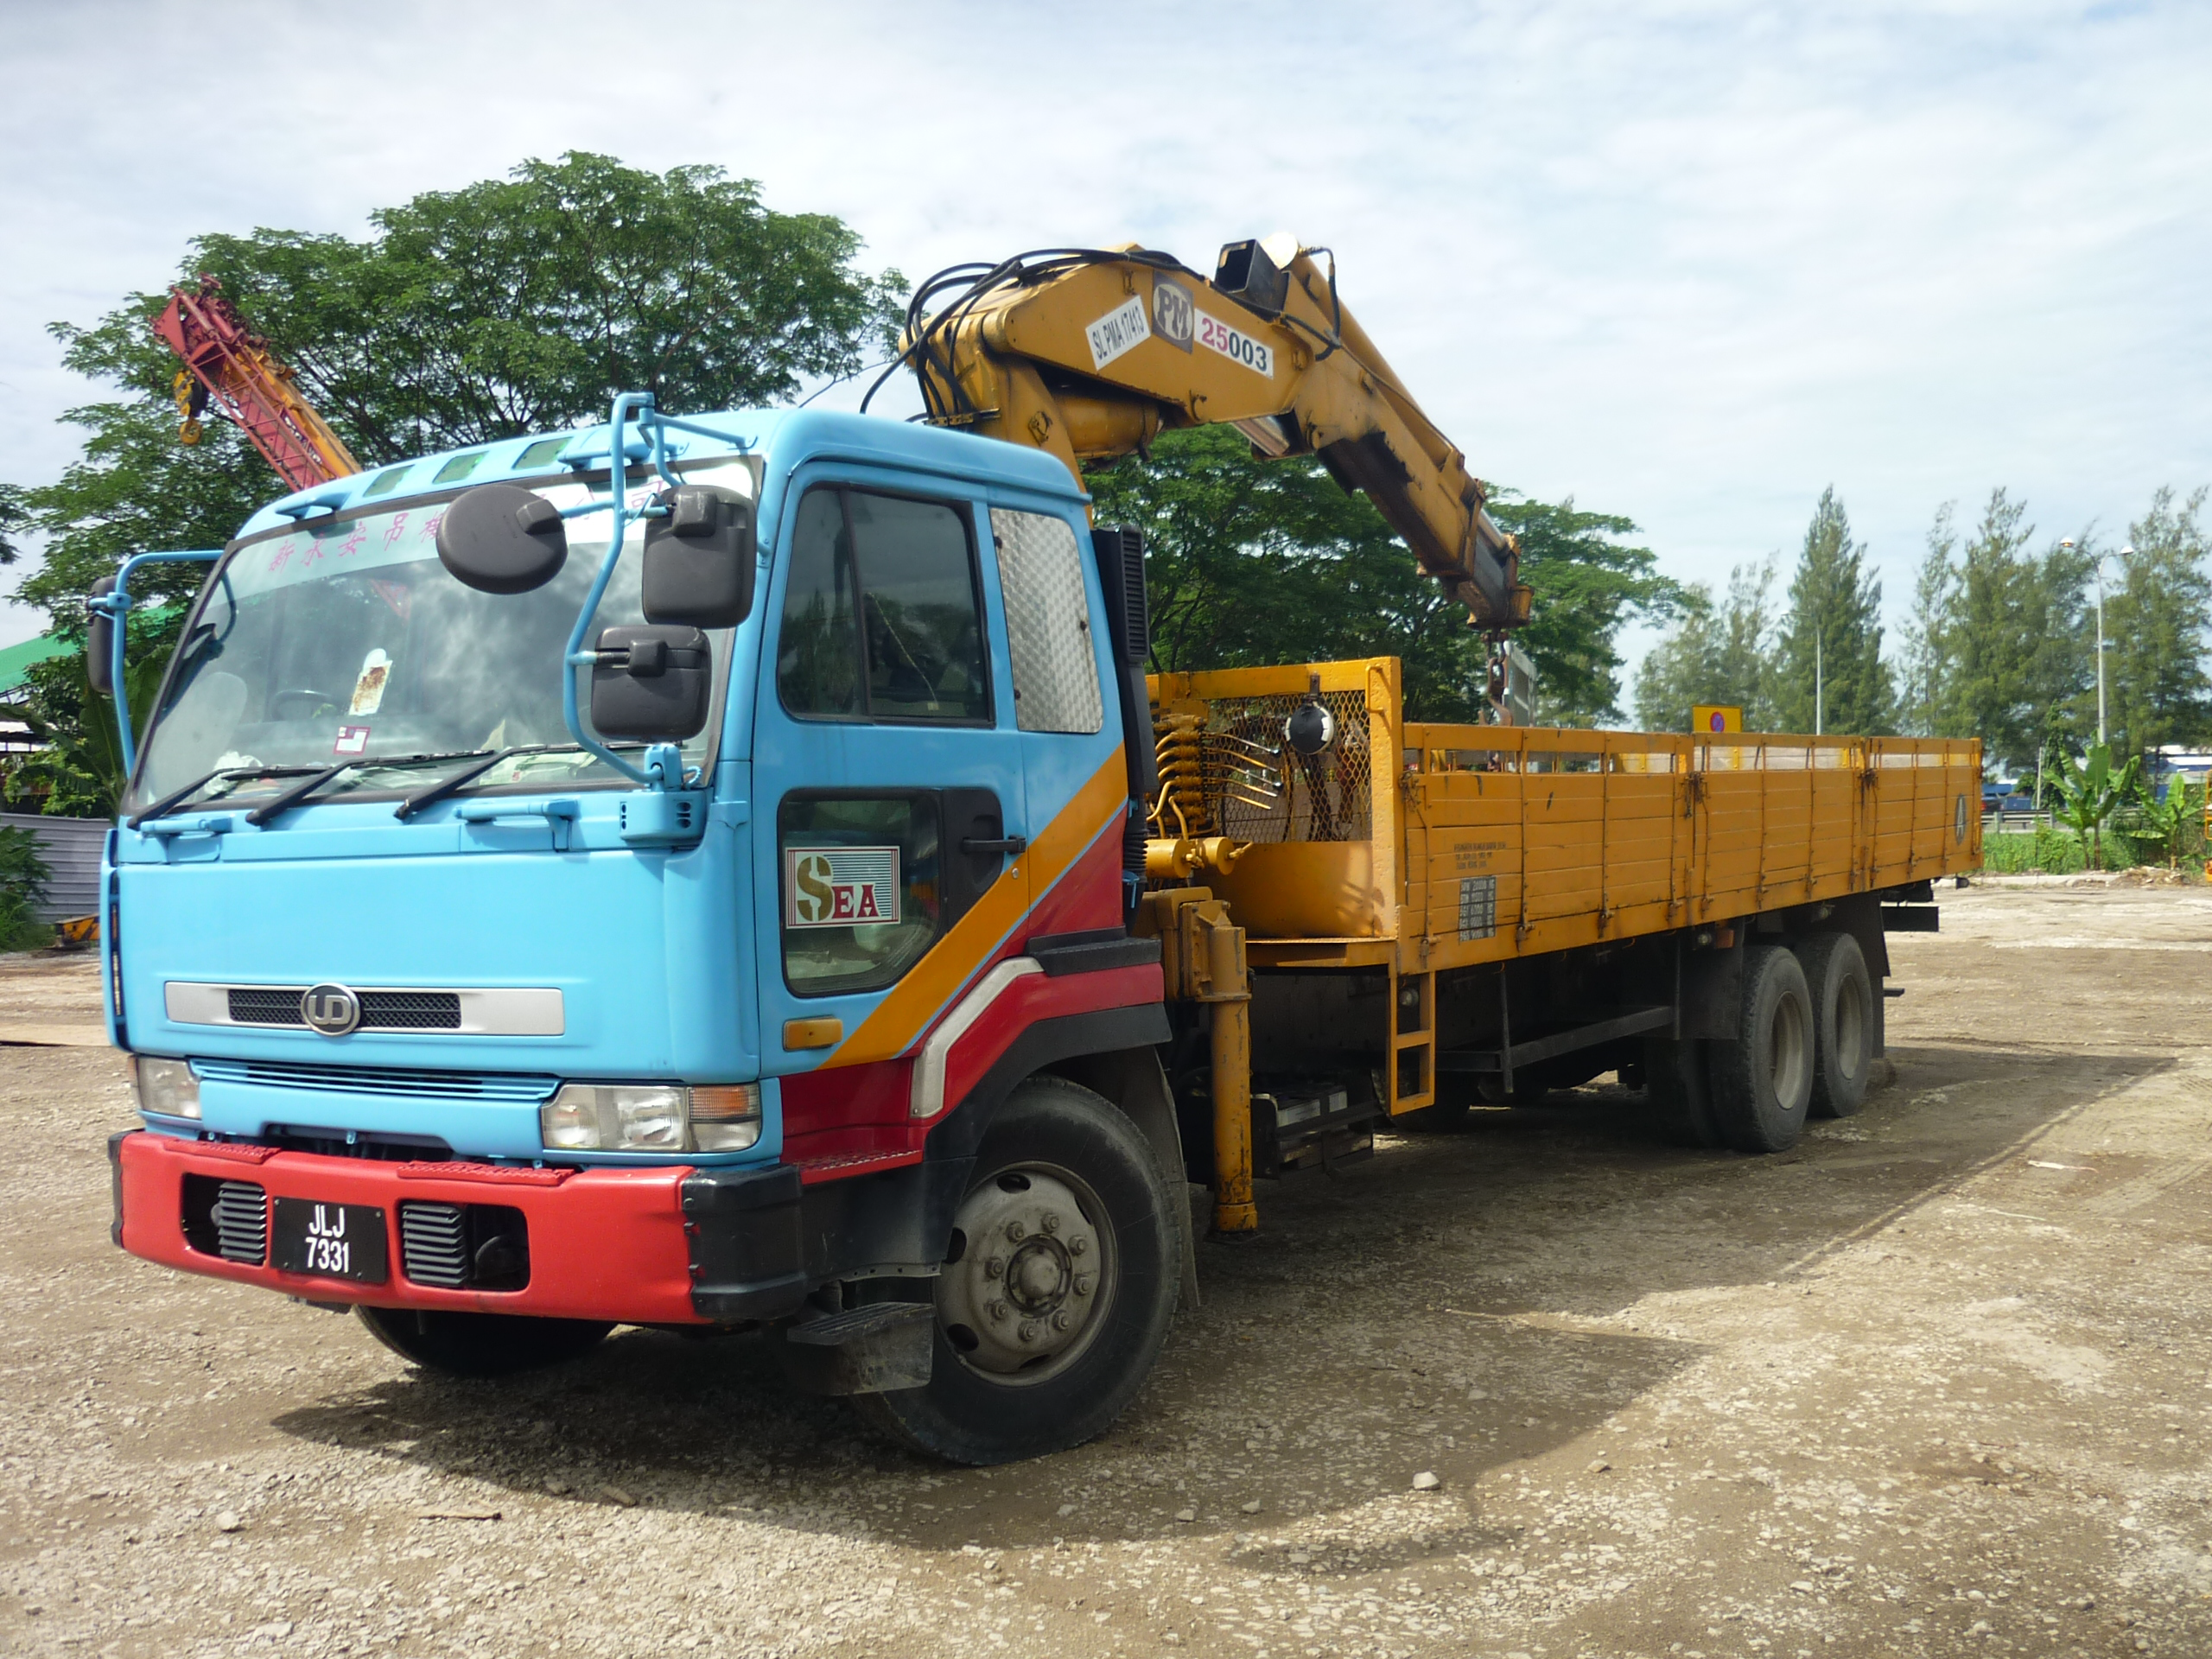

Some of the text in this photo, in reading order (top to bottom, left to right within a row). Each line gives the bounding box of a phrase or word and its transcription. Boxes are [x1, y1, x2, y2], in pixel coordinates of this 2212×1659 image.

[1157, 287, 1189, 339] PM
[1201, 317, 1268, 372] 25003
[306, 995, 352, 1026] UD
[308, 1205, 346, 1237] JLJ
[304, 1236, 350, 1274] 7331
